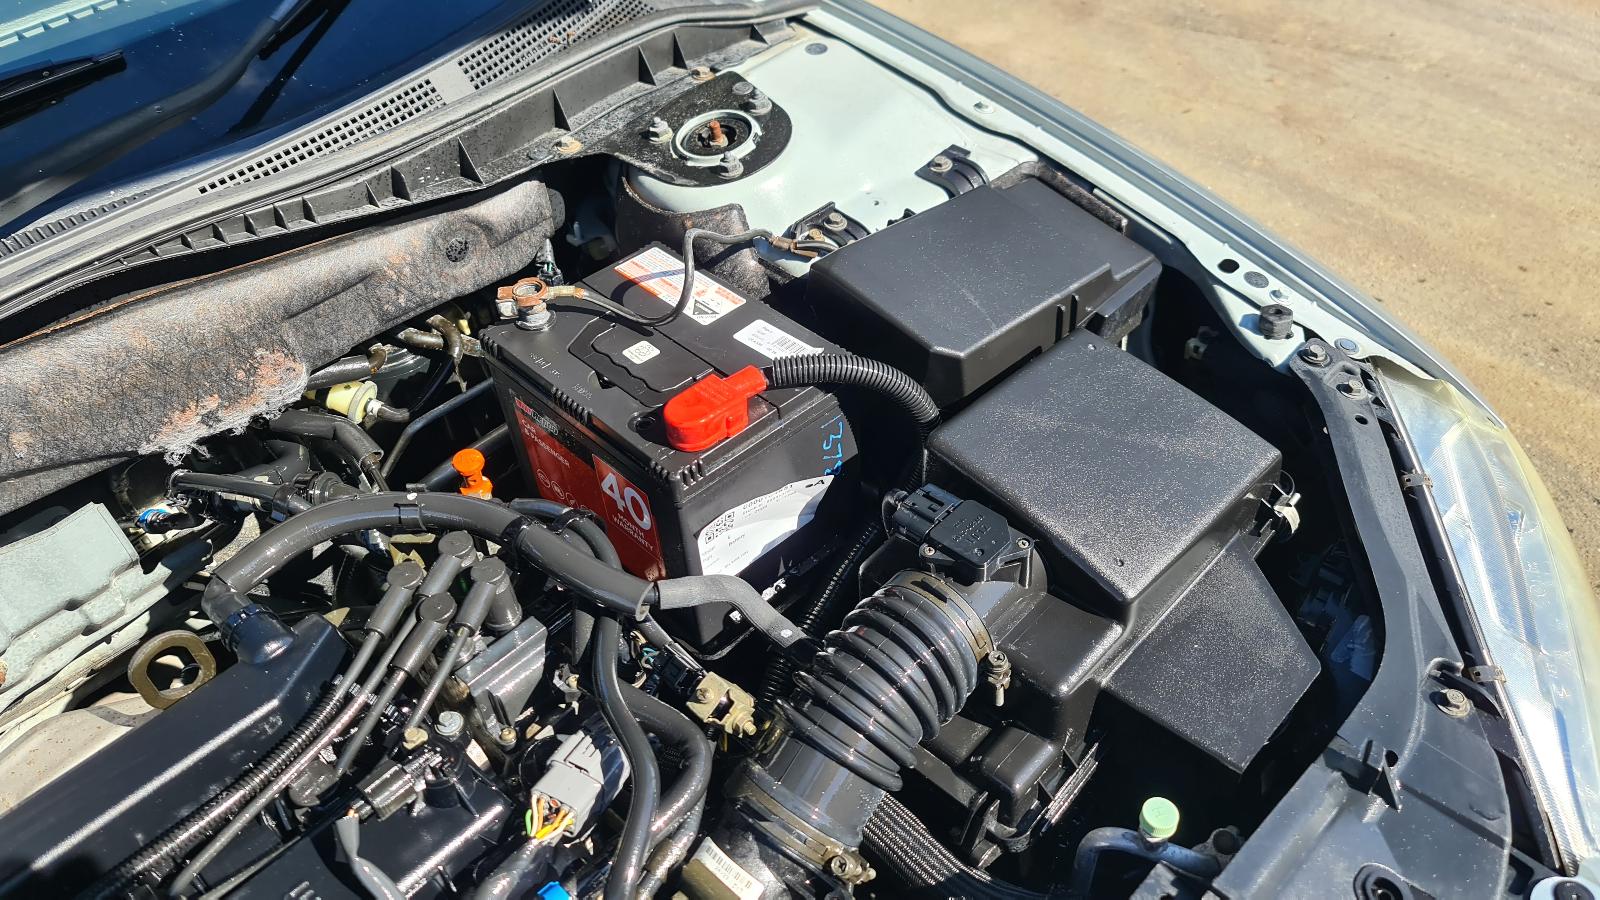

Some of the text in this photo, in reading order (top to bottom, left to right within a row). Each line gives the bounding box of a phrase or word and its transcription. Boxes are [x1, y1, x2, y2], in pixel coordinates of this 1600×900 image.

[521, 419, 537, 433] CAR
[530, 434, 570, 469] PASSENGER
[601, 472, 652, 531] 40
[612, 514, 654, 551] WARRANTY
[617, 512, 645, 538] MONTH
